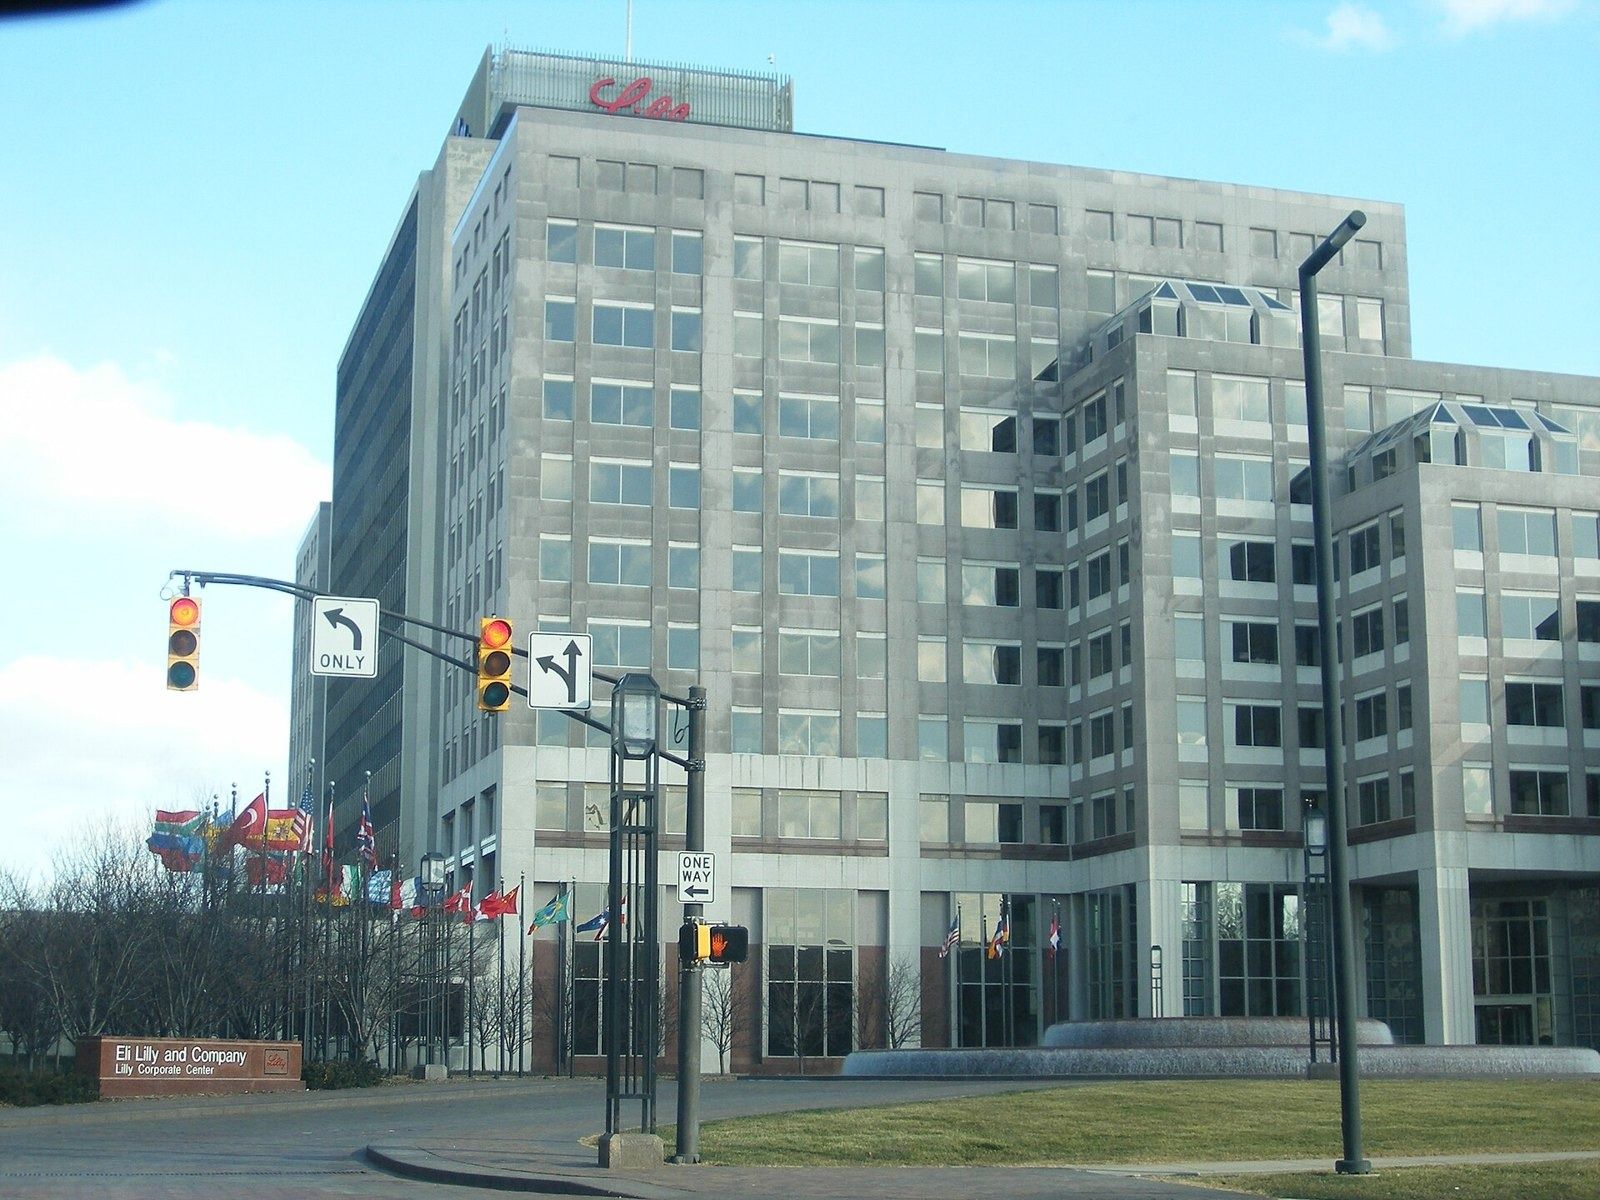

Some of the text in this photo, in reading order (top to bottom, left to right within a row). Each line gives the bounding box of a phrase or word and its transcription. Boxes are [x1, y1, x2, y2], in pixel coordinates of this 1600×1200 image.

[320, 653, 365, 670] ONLY
[683, 856, 711, 869] ONE
[682, 870, 711, 883] WAY
[116, 1045, 247, 1066] Eli Lilly and Company
[115, 1063, 215, 1077] Lilly Corporate Center
